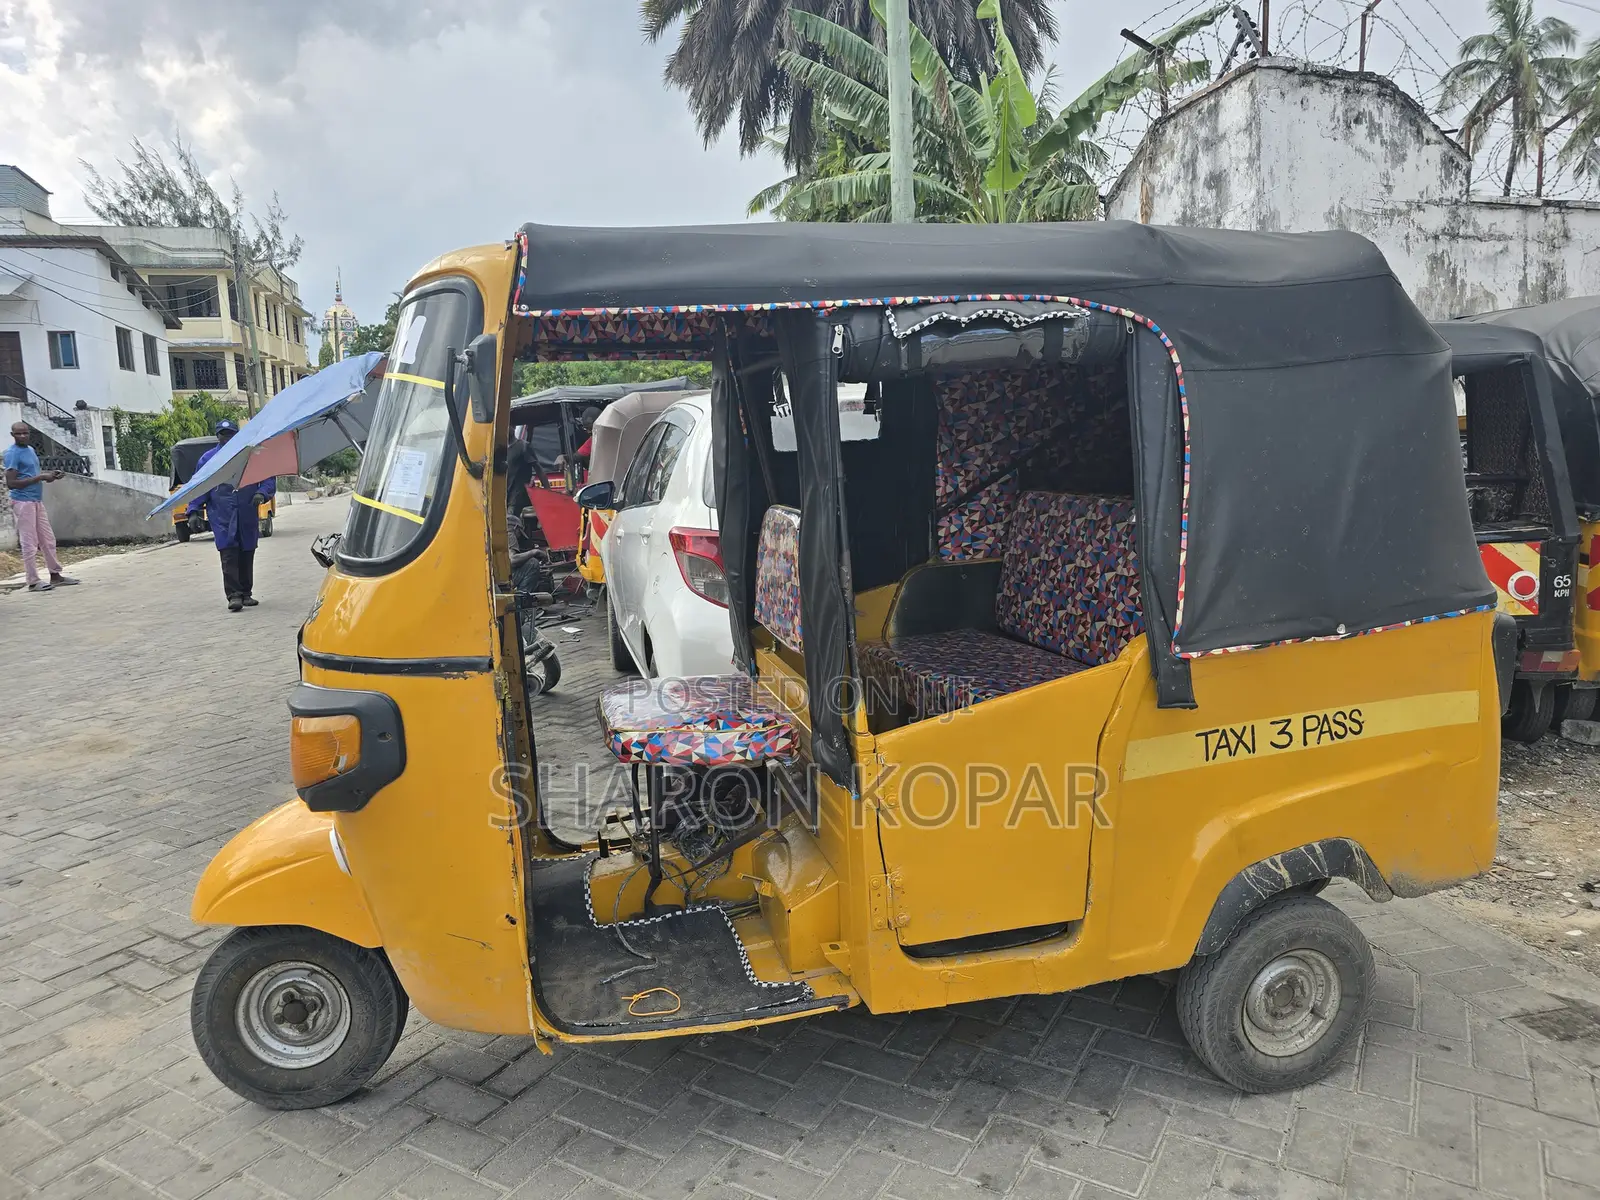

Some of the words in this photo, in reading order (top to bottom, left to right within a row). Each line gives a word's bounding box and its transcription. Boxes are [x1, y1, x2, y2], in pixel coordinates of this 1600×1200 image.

[1553, 574, 1571, 588] 65
[1554, 589, 1570, 598] KPH
[1195, 724, 1256, 762] TAXI
[1269, 718, 1293, 749] 3
[1302, 708, 1365, 747] PASS
